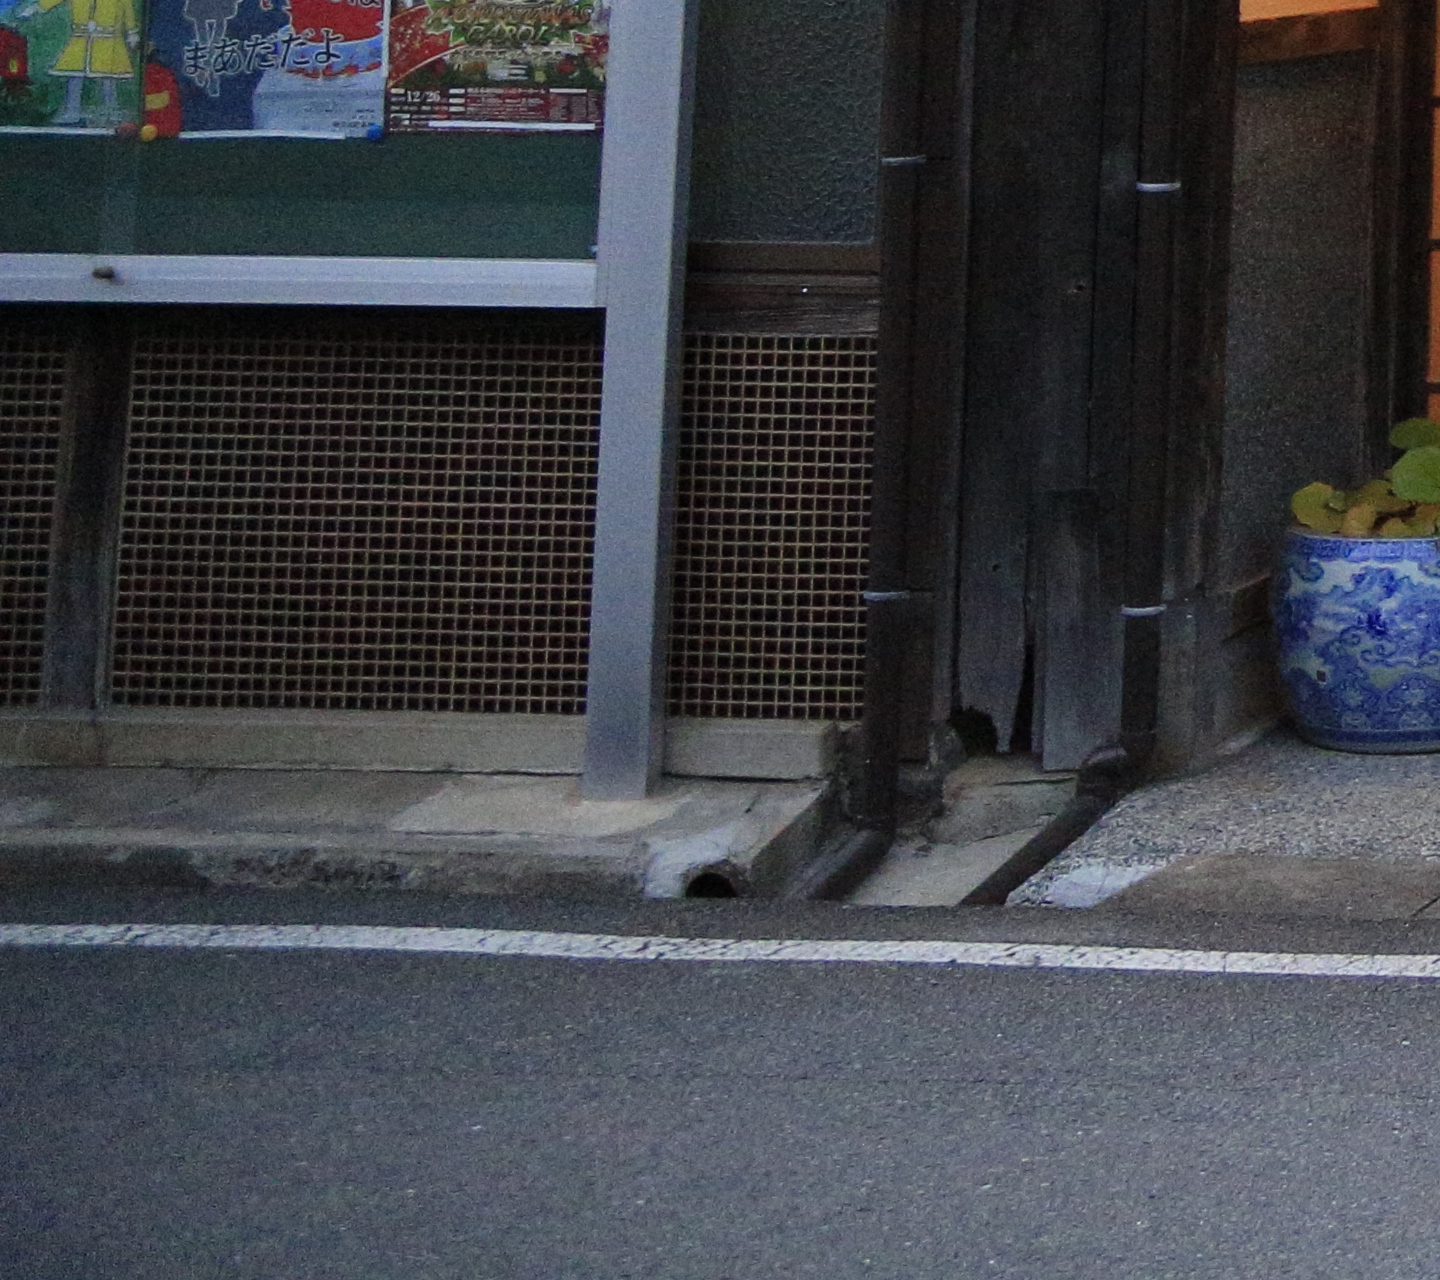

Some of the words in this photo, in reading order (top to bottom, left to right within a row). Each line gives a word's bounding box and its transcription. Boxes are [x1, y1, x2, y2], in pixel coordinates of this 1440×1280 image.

[183, 28, 344, 78] まあだだよ
[406, 90, 441, 102] 12/26
